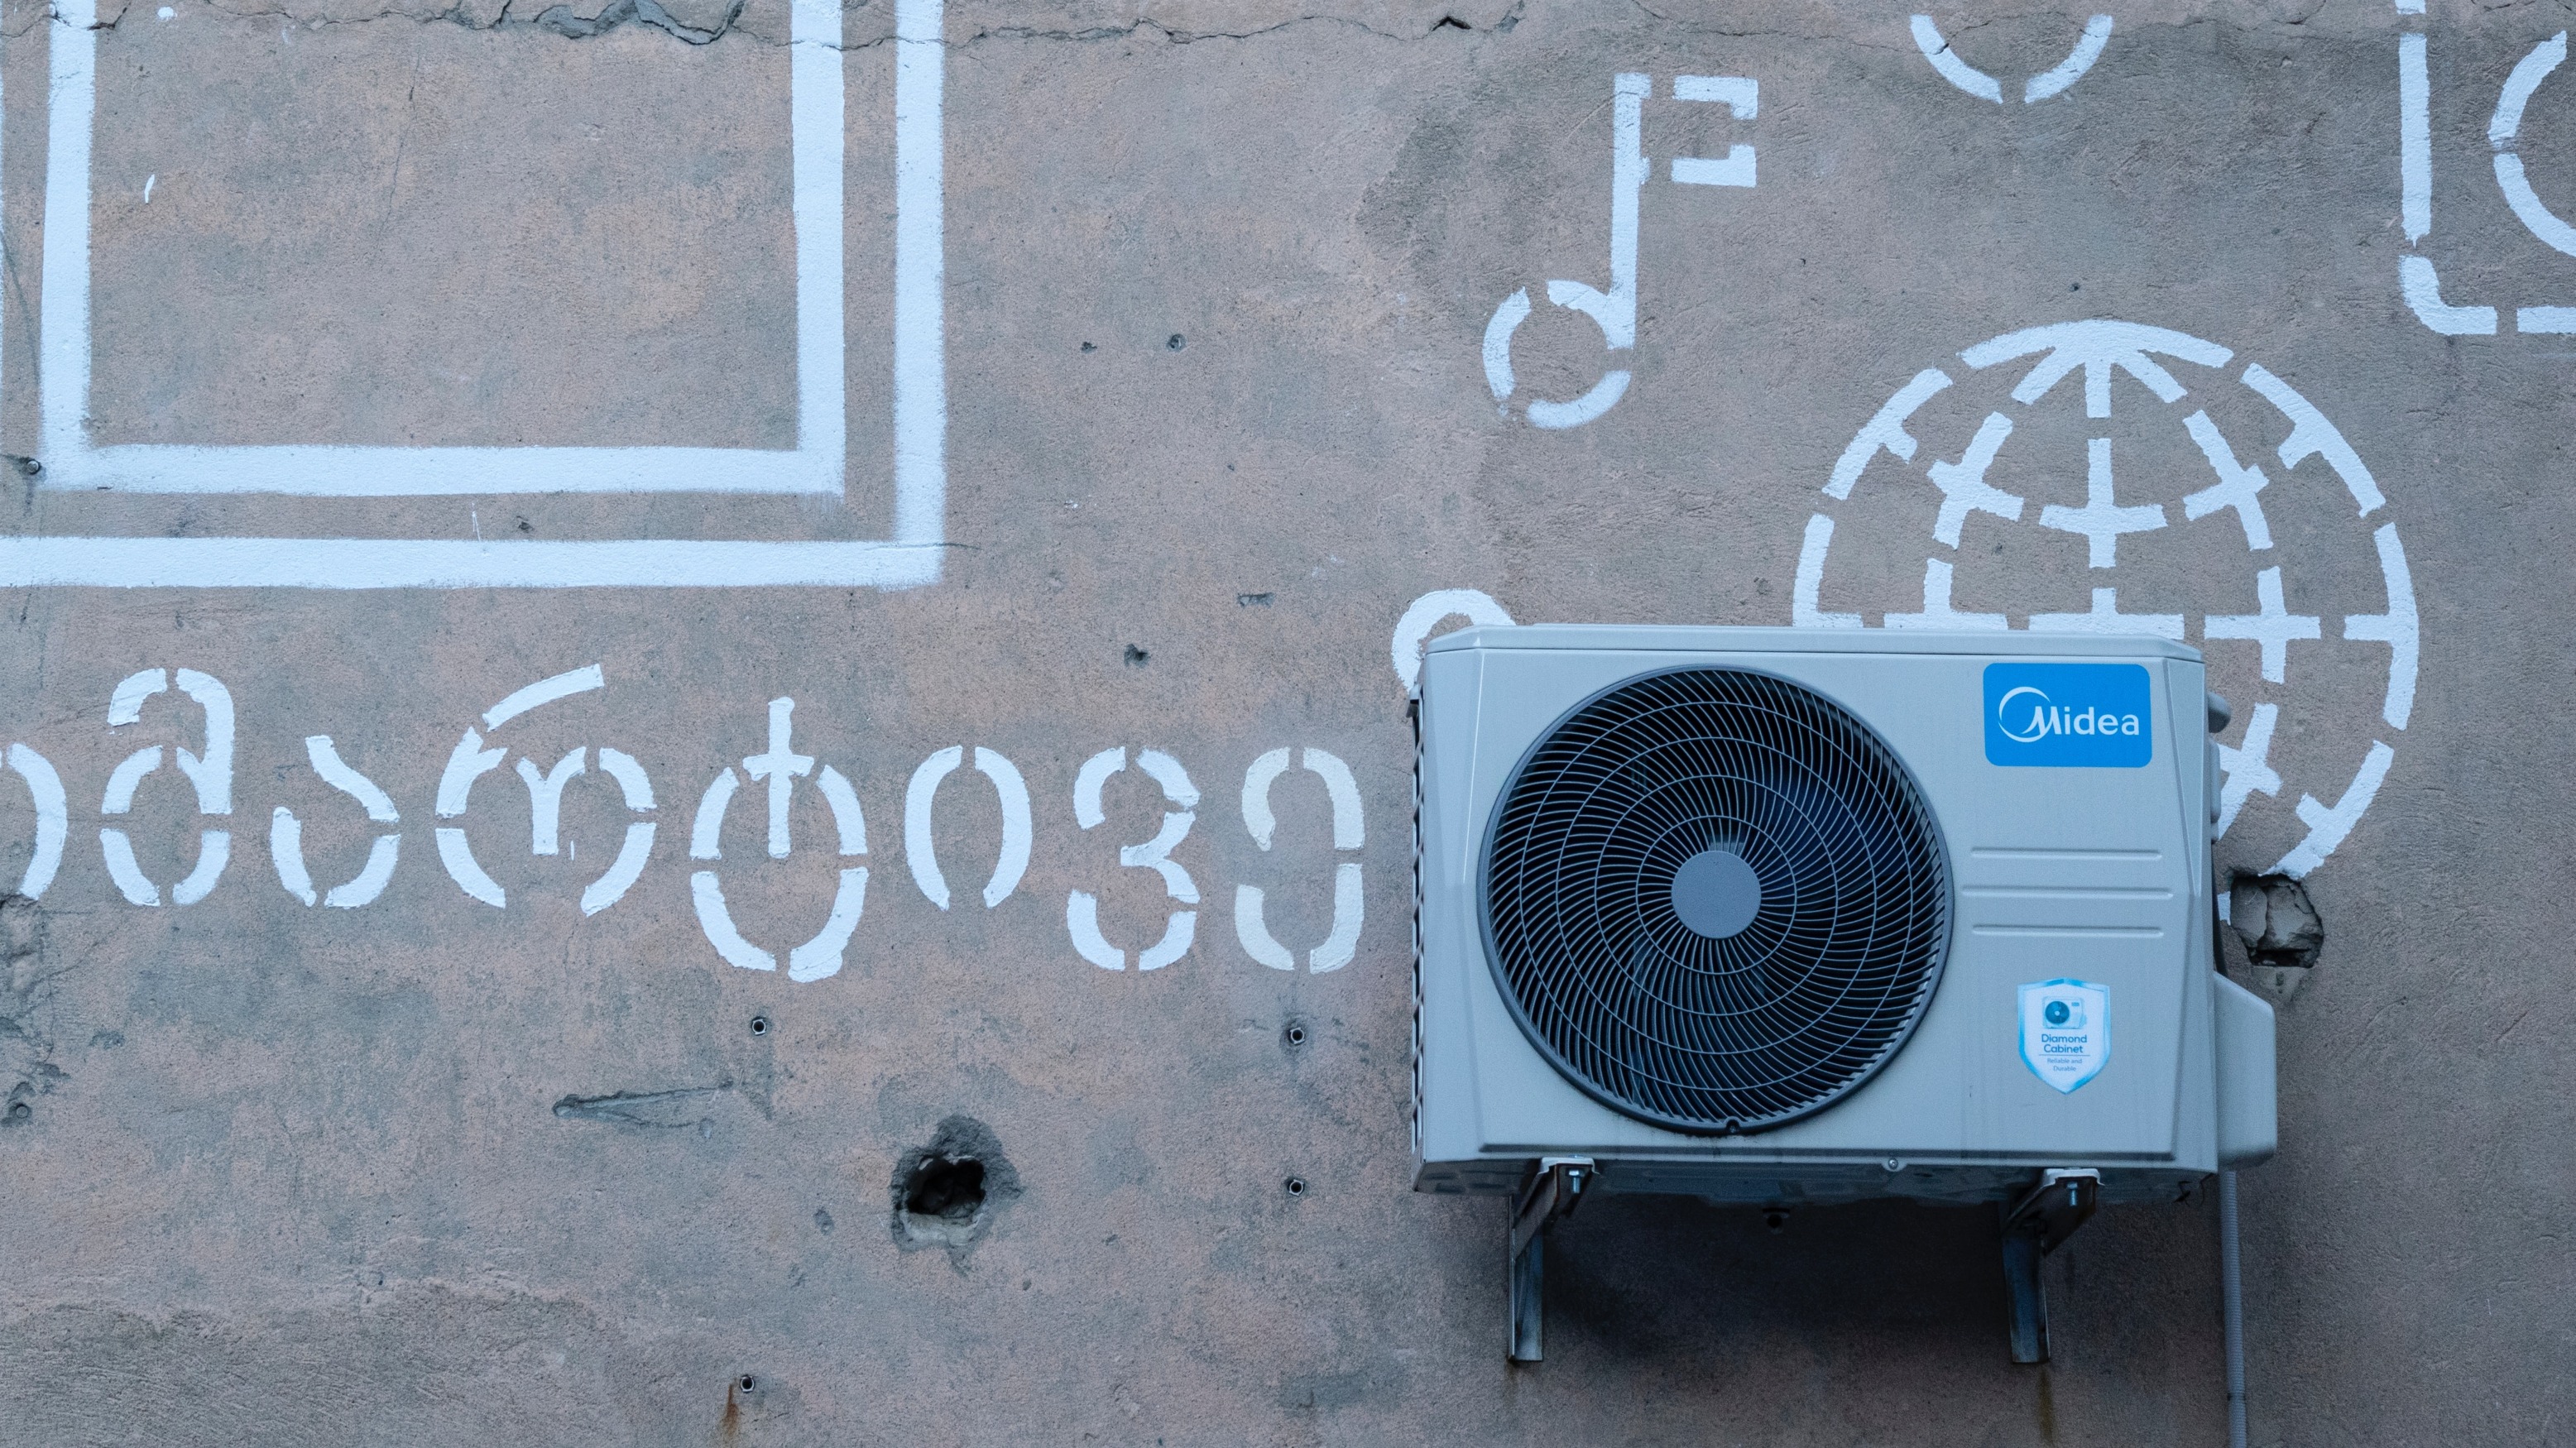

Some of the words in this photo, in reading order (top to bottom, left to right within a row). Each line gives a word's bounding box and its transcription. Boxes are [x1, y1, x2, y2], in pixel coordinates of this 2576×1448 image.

[2012, 698, 2140, 739] Midea
[2041, 1034, 2087, 1043] Diamond
[2044, 1044, 2084, 1052] Cabinet
